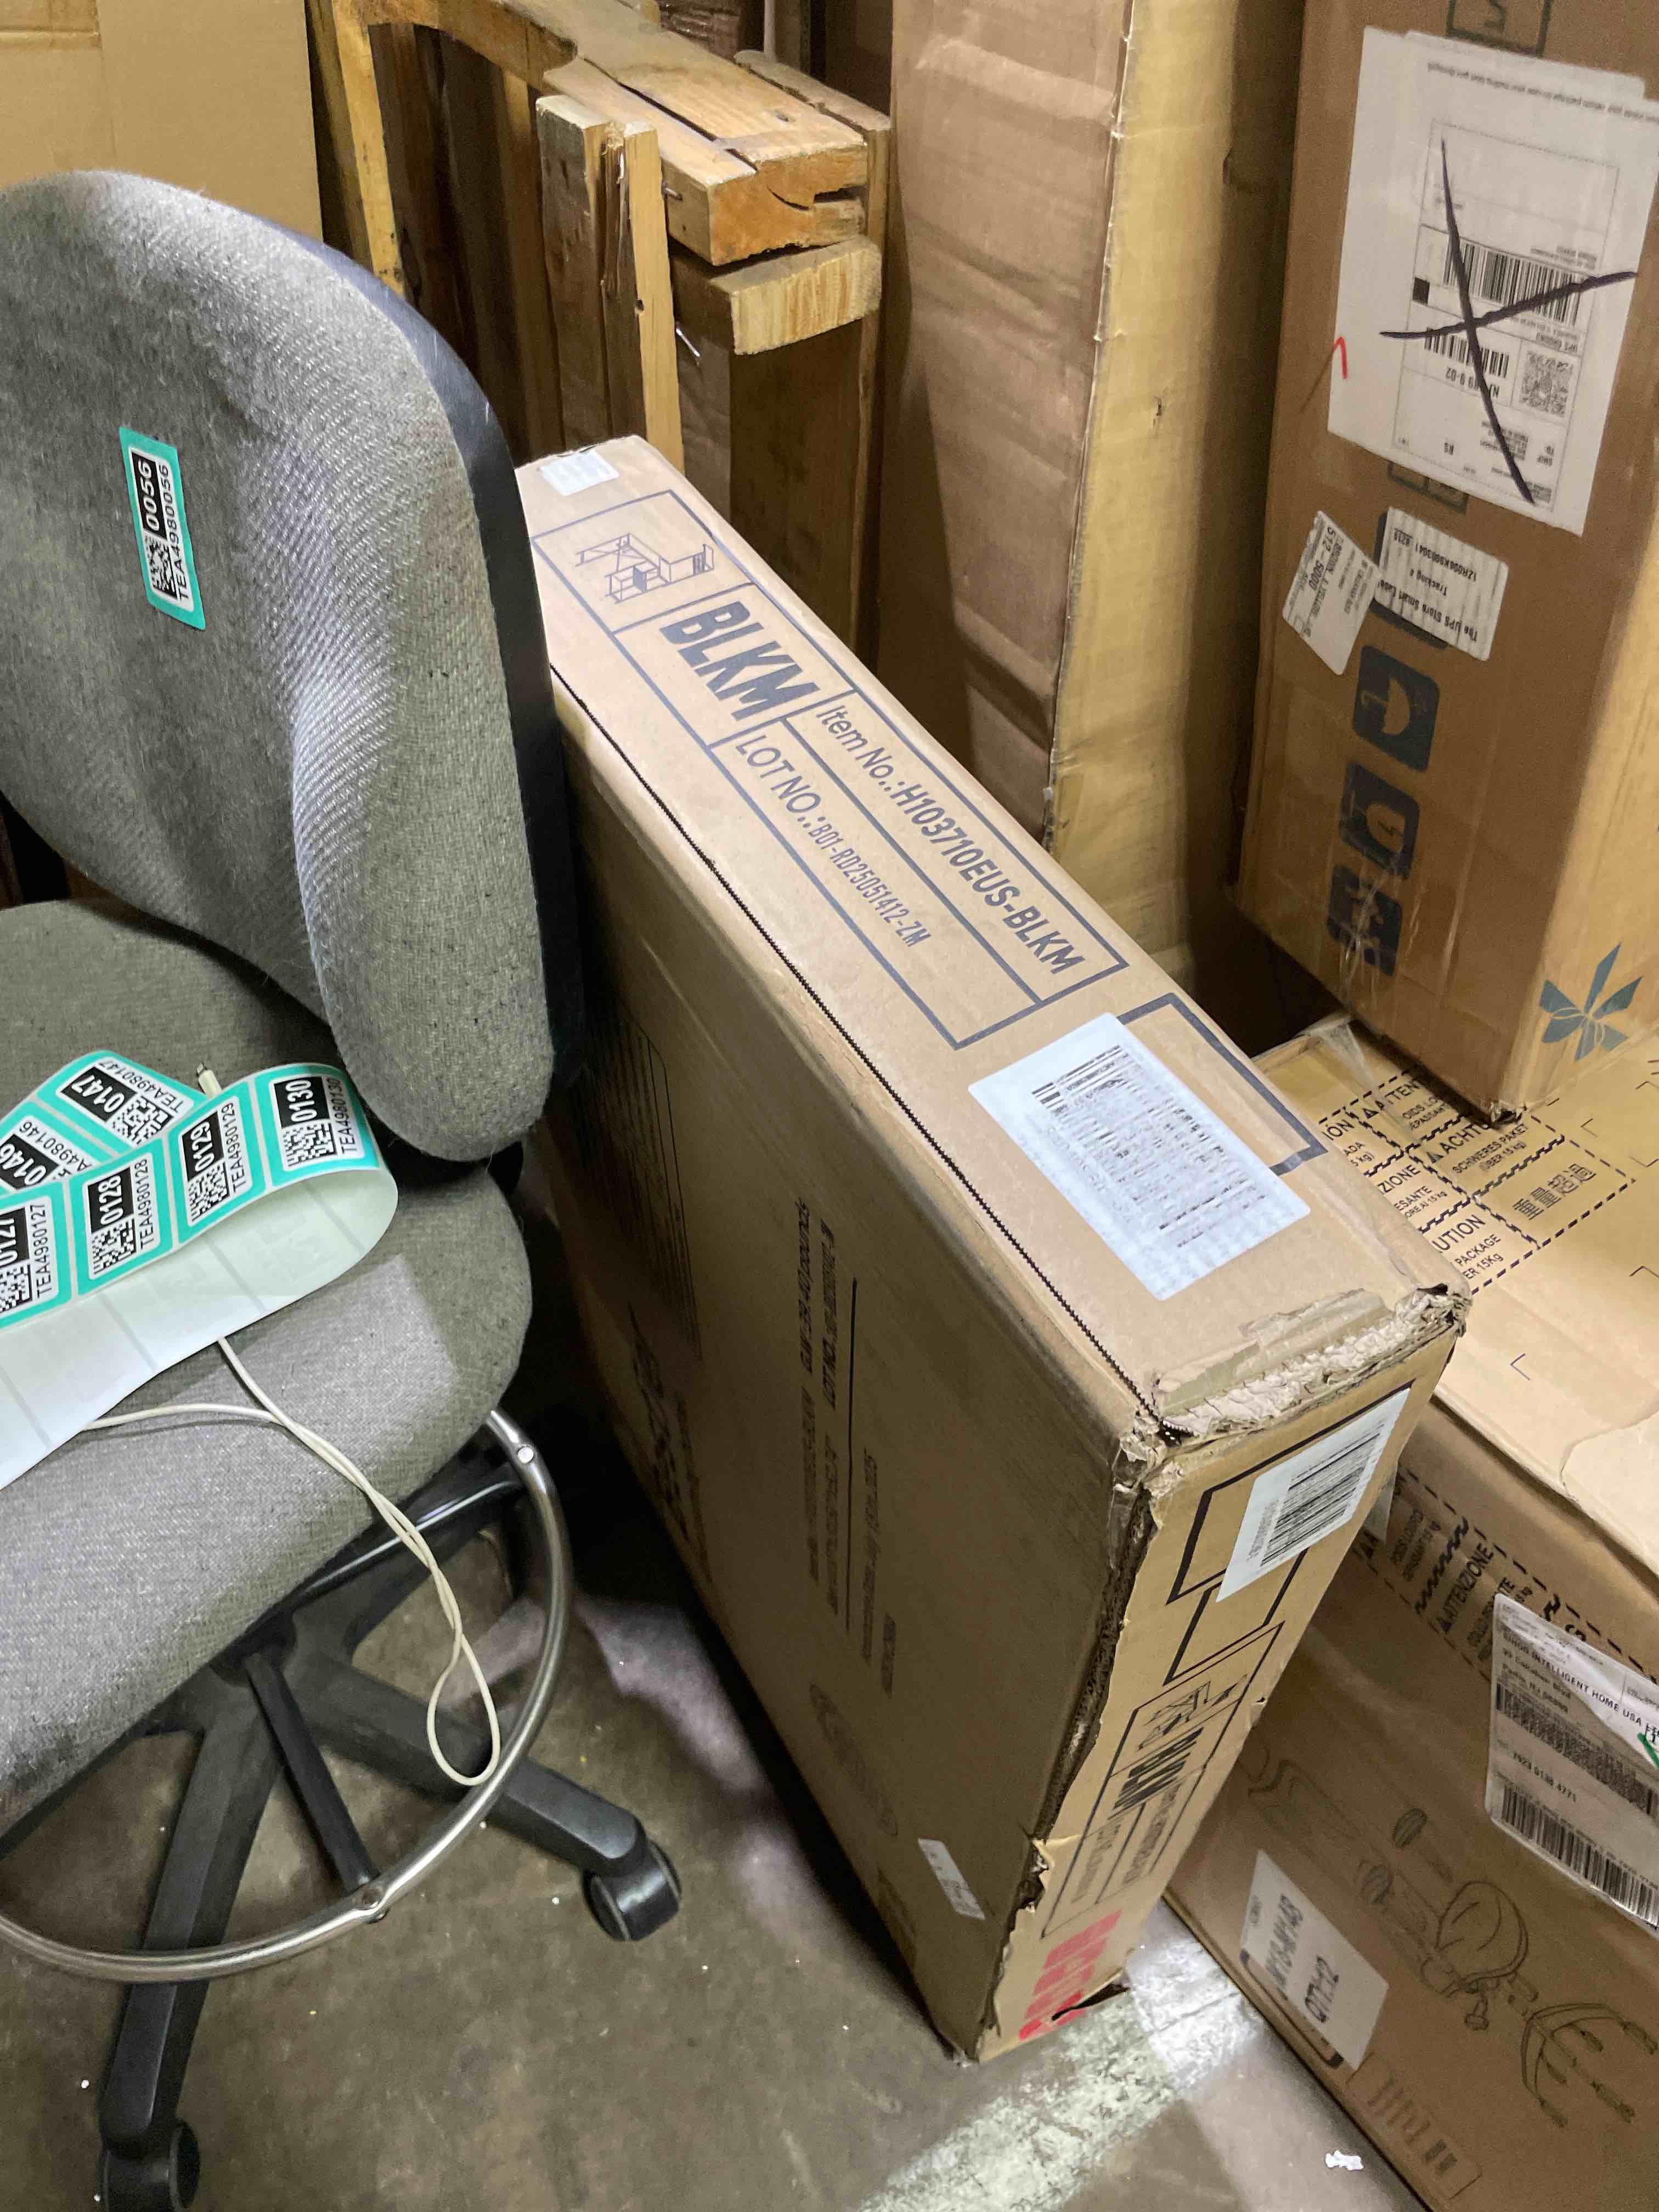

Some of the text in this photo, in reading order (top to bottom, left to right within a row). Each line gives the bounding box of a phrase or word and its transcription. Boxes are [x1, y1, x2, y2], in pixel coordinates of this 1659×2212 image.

[138, 460, 160, 532] 0056
[159, 464, 189, 601] TEA4980056
[658, 601, 821, 721] BLKM
[733, 733, 794, 780] LOT
[815, 704, 868, 761] Item
[71, 1074, 125, 1113] 0147
[98, 1059, 184, 1114] TEA4980147
[285, 1079, 318, 1123] 0130
[19, 1121, 92, 1173] A4980146
[190, 1121, 216, 1173] 0129
[221, 1102, 247, 1193] TEA4980129
[97, 1175, 124, 1226] 0128
[134, 1158, 155, 1251] TEA4980128
[30, 1203, 53, 1299] TEA4980127
[1454, 1234, 1502, 1267] PACKAGE
[1442, 1542, 1494, 1618] ATTENZIONE
[1592, 1689, 1620, 1712] HOME
[1622, 1708, 1642, 1726] USA
